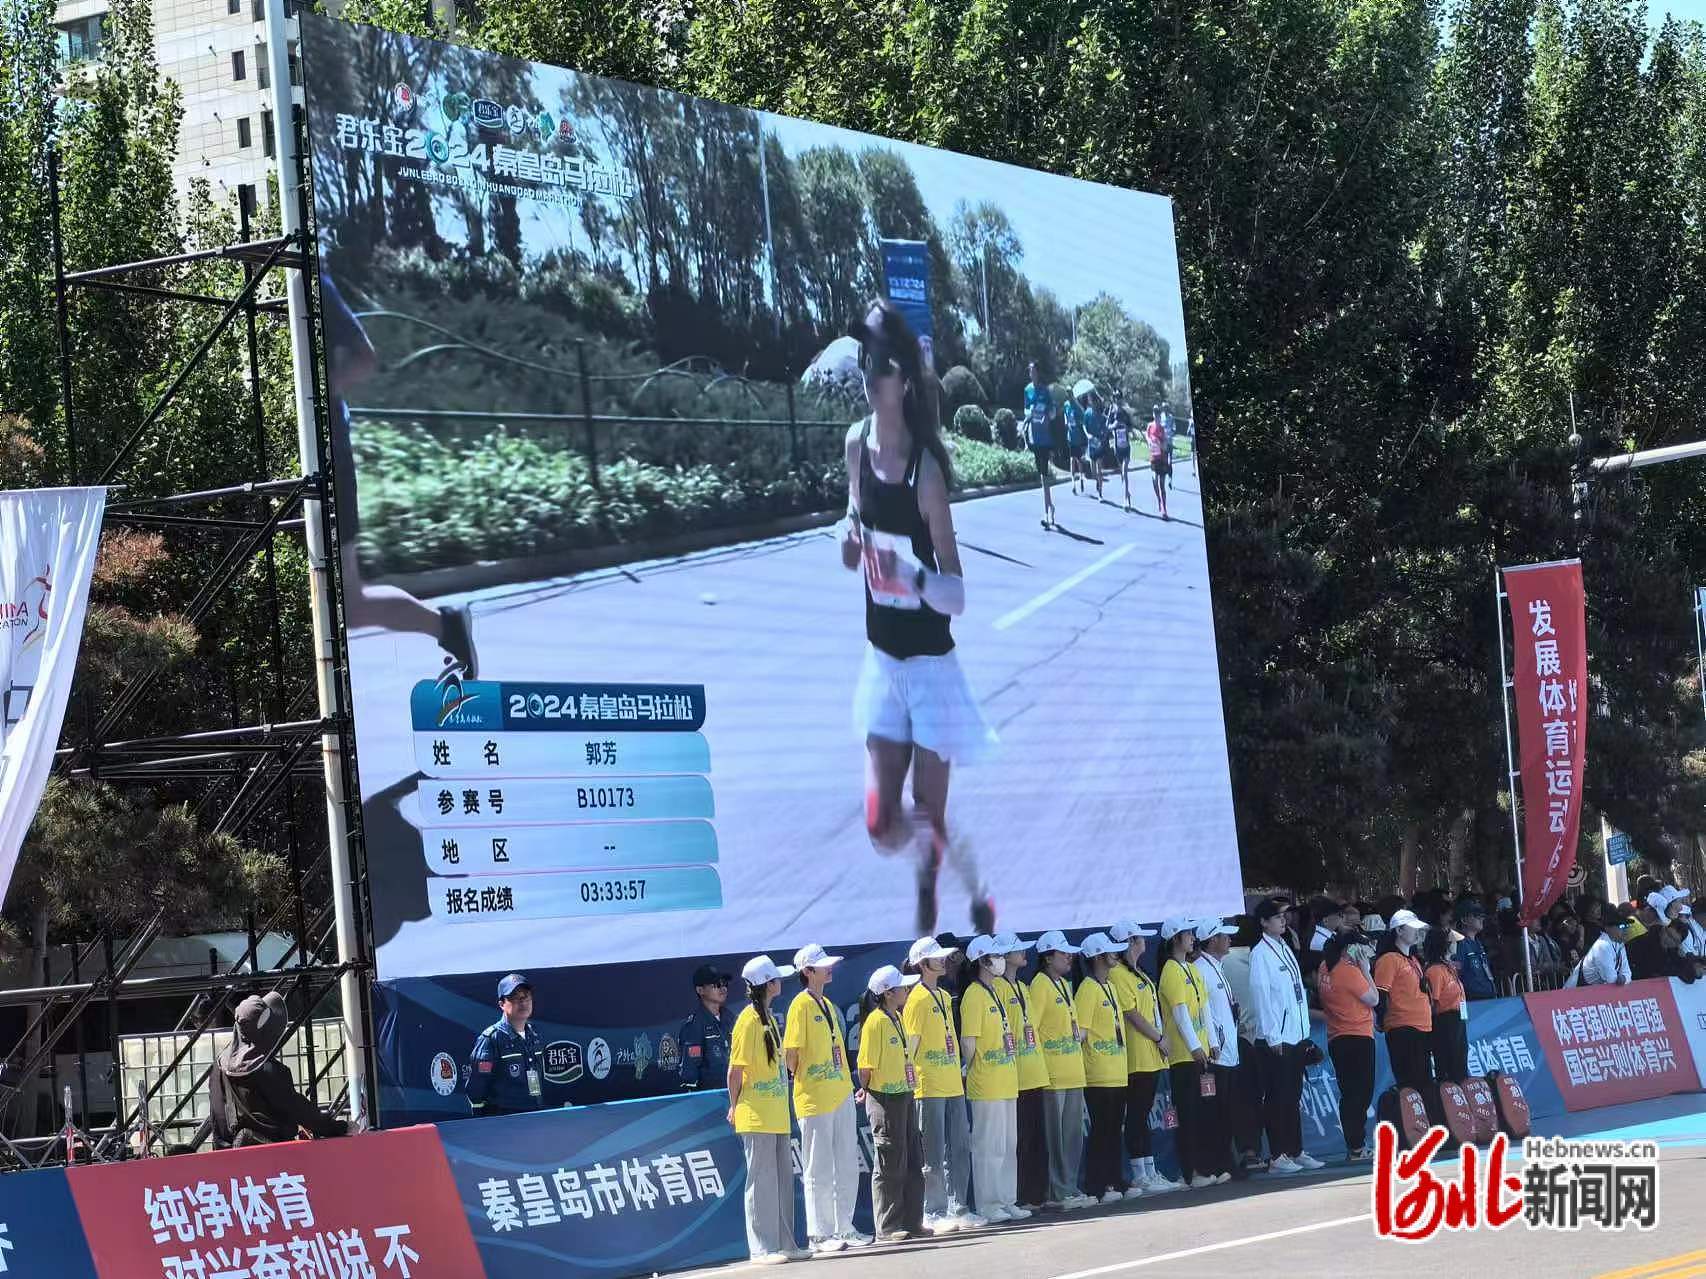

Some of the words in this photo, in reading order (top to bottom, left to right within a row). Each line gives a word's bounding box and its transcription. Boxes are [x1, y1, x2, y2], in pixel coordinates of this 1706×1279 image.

[585, 740, 617, 766] 郭芳
[577, 787, 634, 809] B10173
[446, 886, 514, 914] 报名成绩
[580, 879, 647, 903] 03:33:57
[1552, 998, 1666, 1046] 体育强则中国强
[548, 1048, 577, 1066] 君乐宝
[1562, 1036, 1677, 1086] 国运兴则体育兴
[144, 1171, 316, 1245] 纯净体育
[478, 1150, 726, 1233] 秦皇岛市体育局
